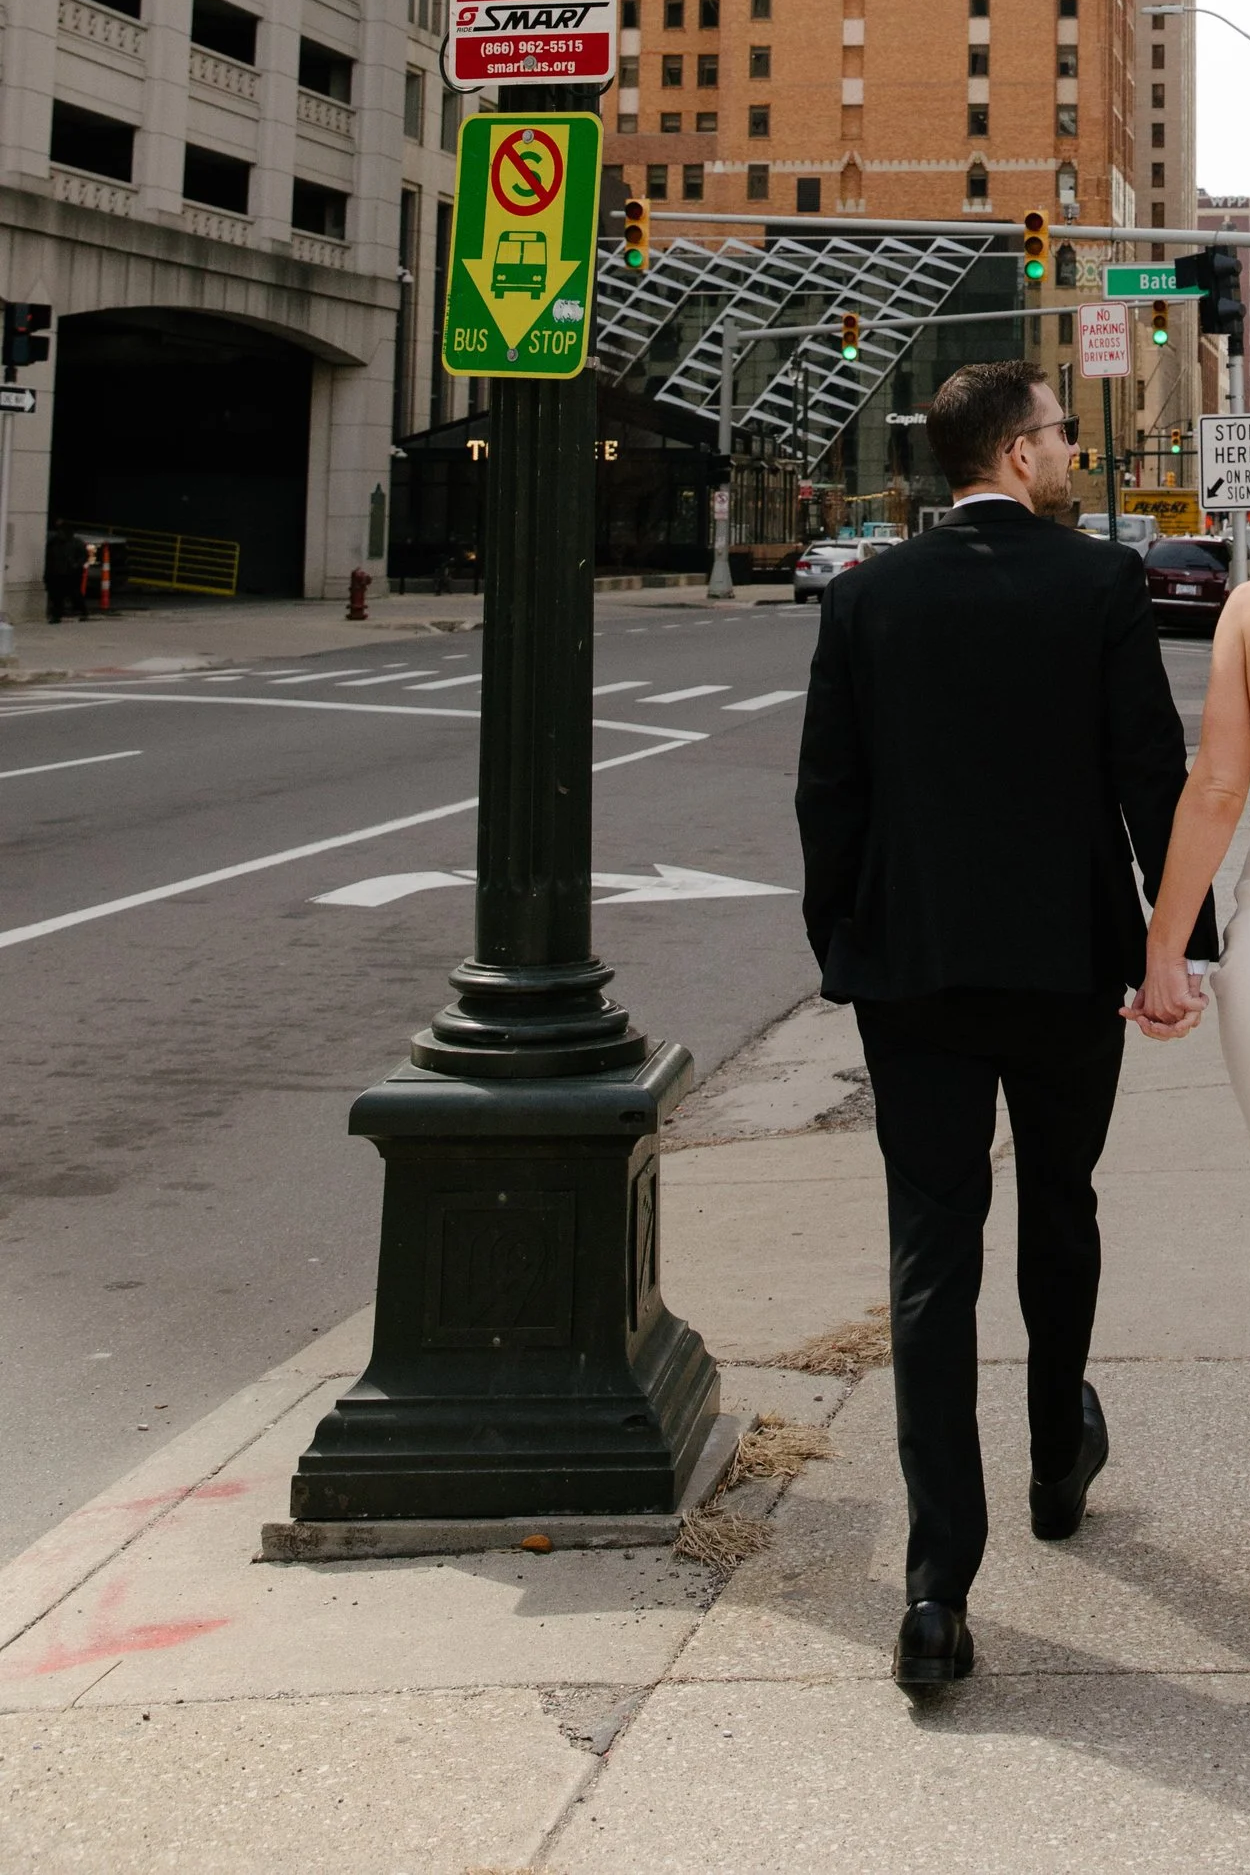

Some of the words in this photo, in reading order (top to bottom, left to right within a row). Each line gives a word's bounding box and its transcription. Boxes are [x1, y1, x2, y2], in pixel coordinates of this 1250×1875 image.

[473, 2, 610, 32] SMART
[480, 41, 514, 57] (866)
[518, 39, 583, 54] 962-5515
[487, 60, 576, 74] smartus.org
[1140, 273, 1176, 290] Bate
[1096, 310, 1110, 321] NO
[1082, 324, 1125, 336] PARKING
[454, 328, 488, 352] BUS
[528, 330, 577, 355] STOP
[1088, 337, 1121, 348] ACROSS
[1084, 350, 1126, 362] DRIVEWAY
[1226, 470, 1240, 483] ON
